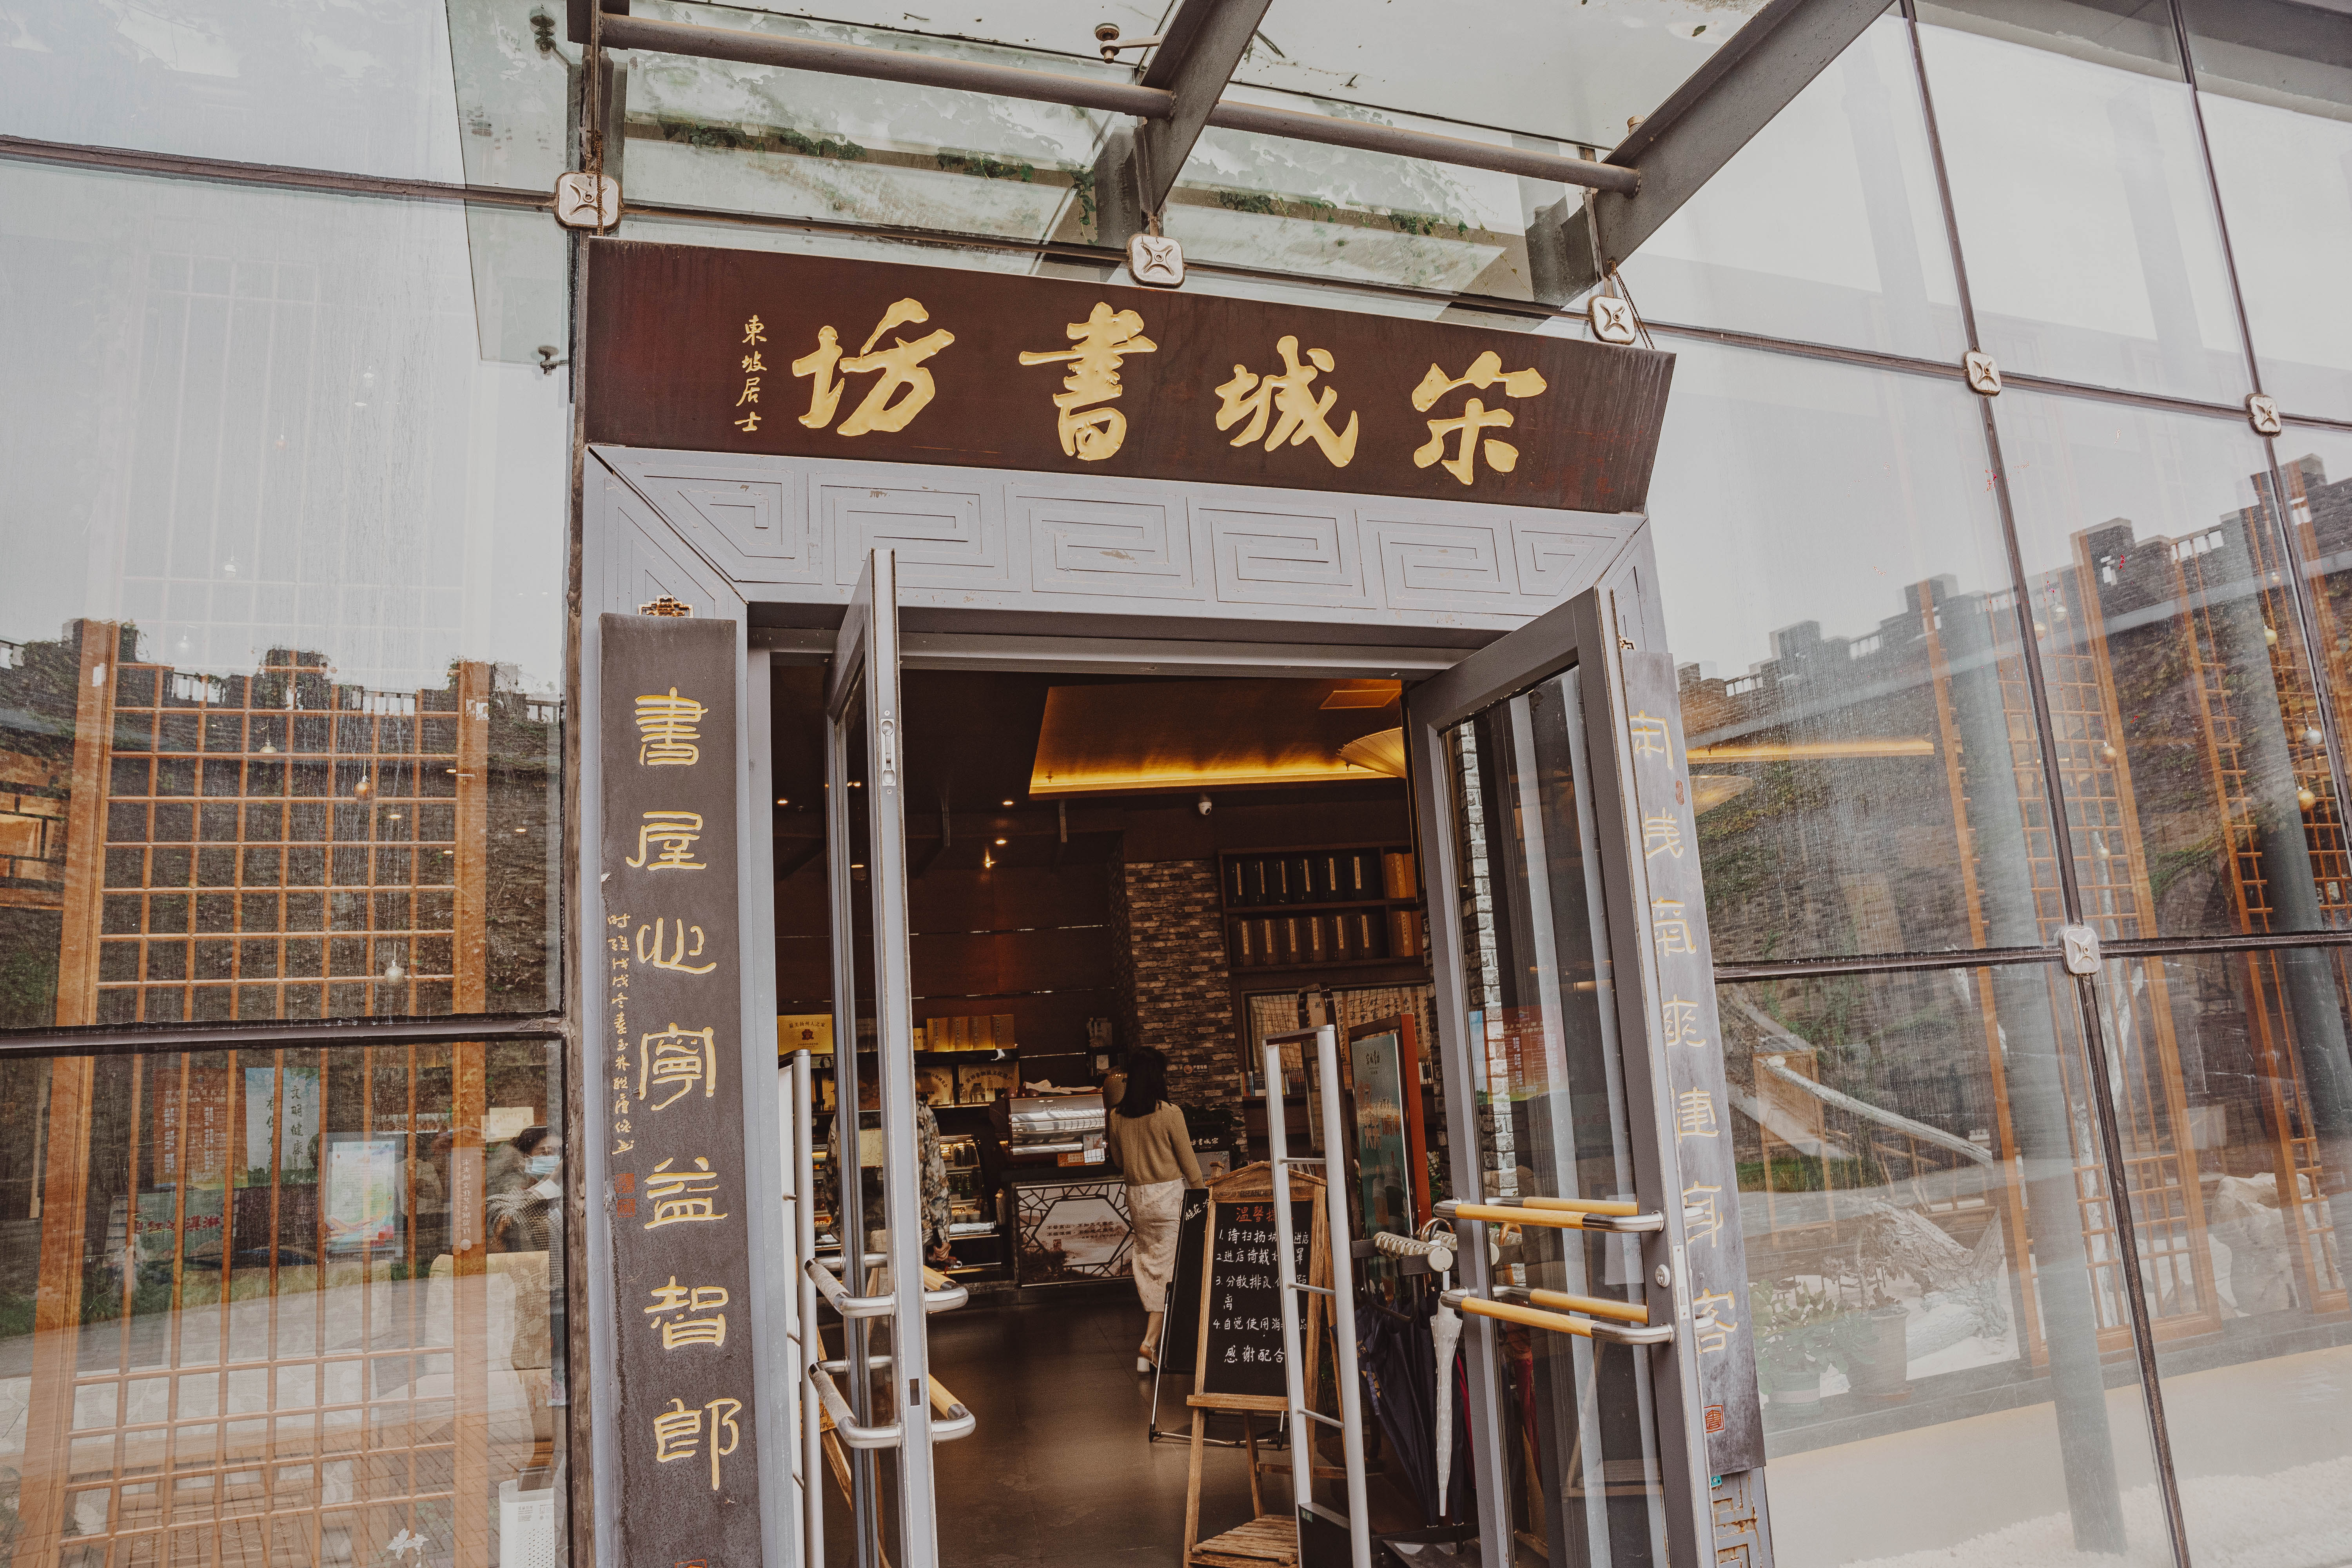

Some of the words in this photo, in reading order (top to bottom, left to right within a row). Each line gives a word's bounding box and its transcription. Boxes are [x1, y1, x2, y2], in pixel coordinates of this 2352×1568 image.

[734, 314, 767, 432] 東坡居士
[291, 1085, 303, 1155] 文明健康
[1223, 1294, 1233, 1310] 离
[1224, 1345, 1285, 1363] 感谢配合
